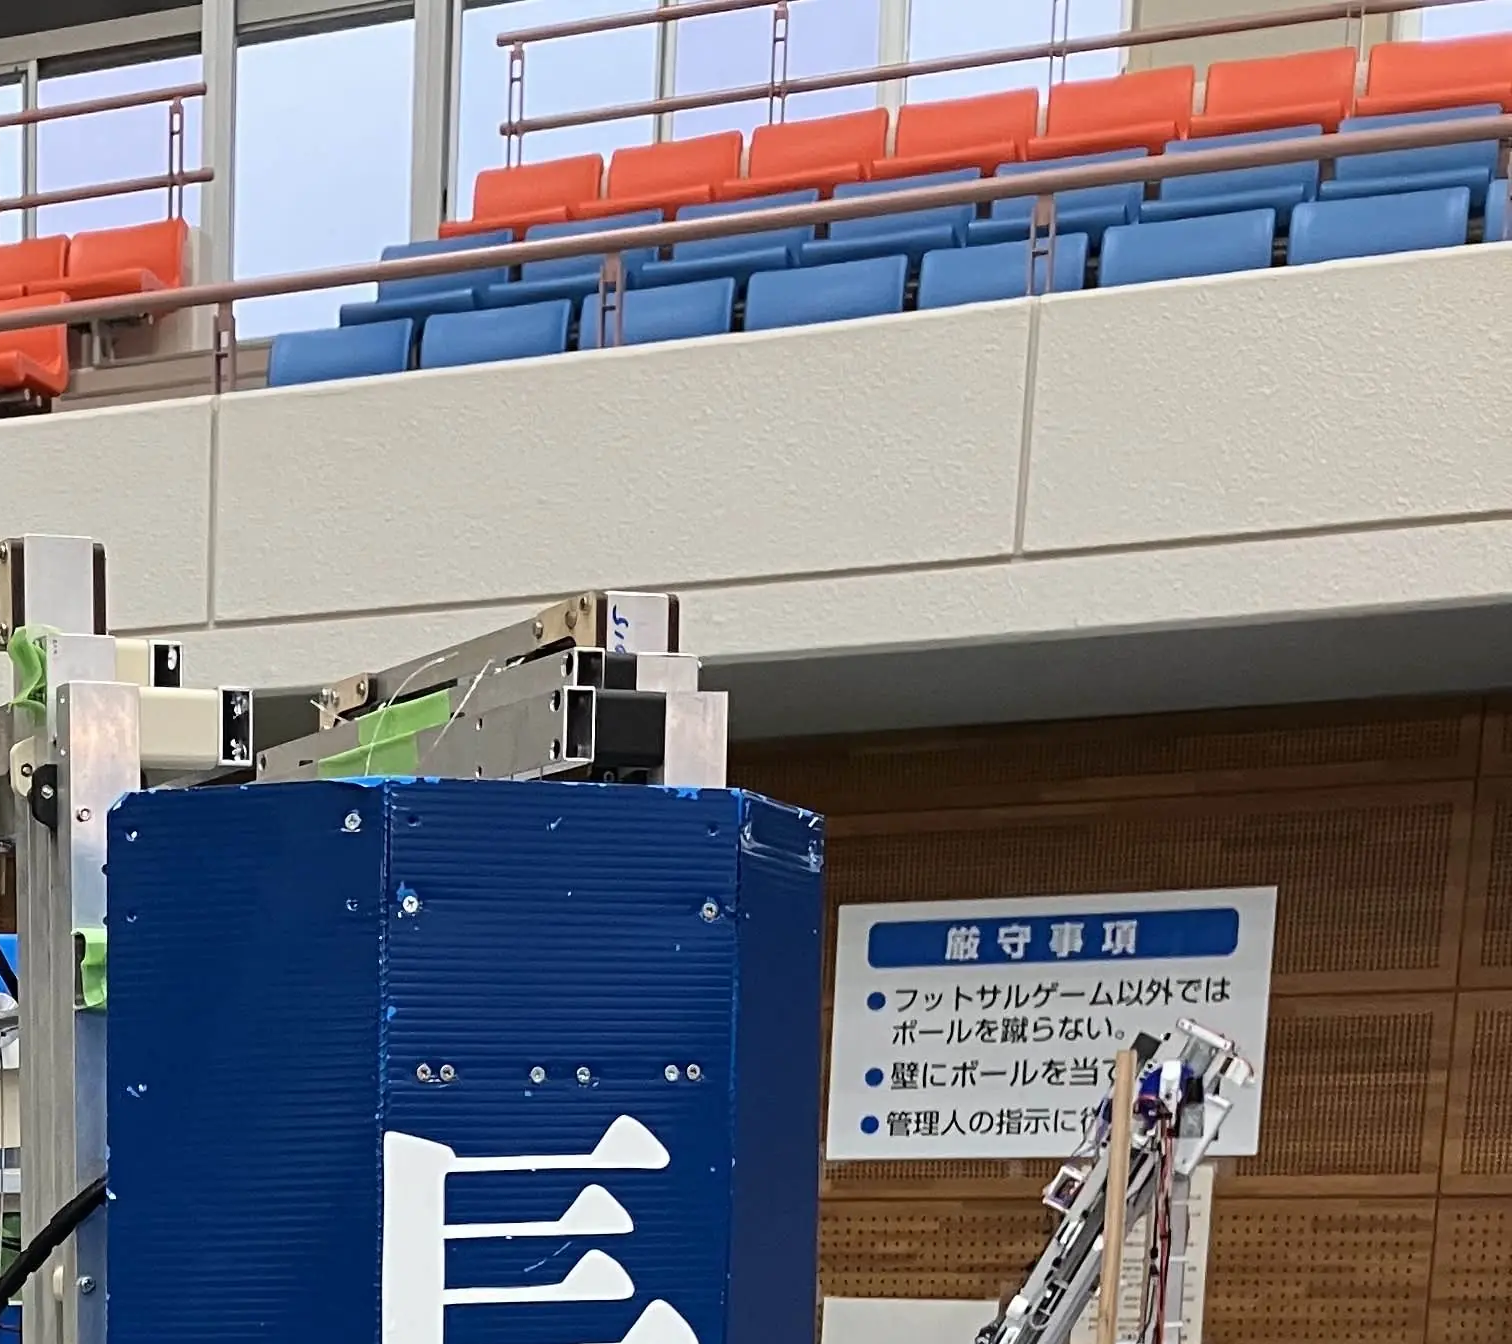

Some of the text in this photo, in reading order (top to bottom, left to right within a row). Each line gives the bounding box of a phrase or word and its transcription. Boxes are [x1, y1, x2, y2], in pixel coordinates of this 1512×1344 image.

[944, 919, 1138, 961] 厳守事項
[894, 975, 1231, 1013] フットサルゲーム以外では
[891, 1016, 1125, 1046] ボールを蹴らない。
